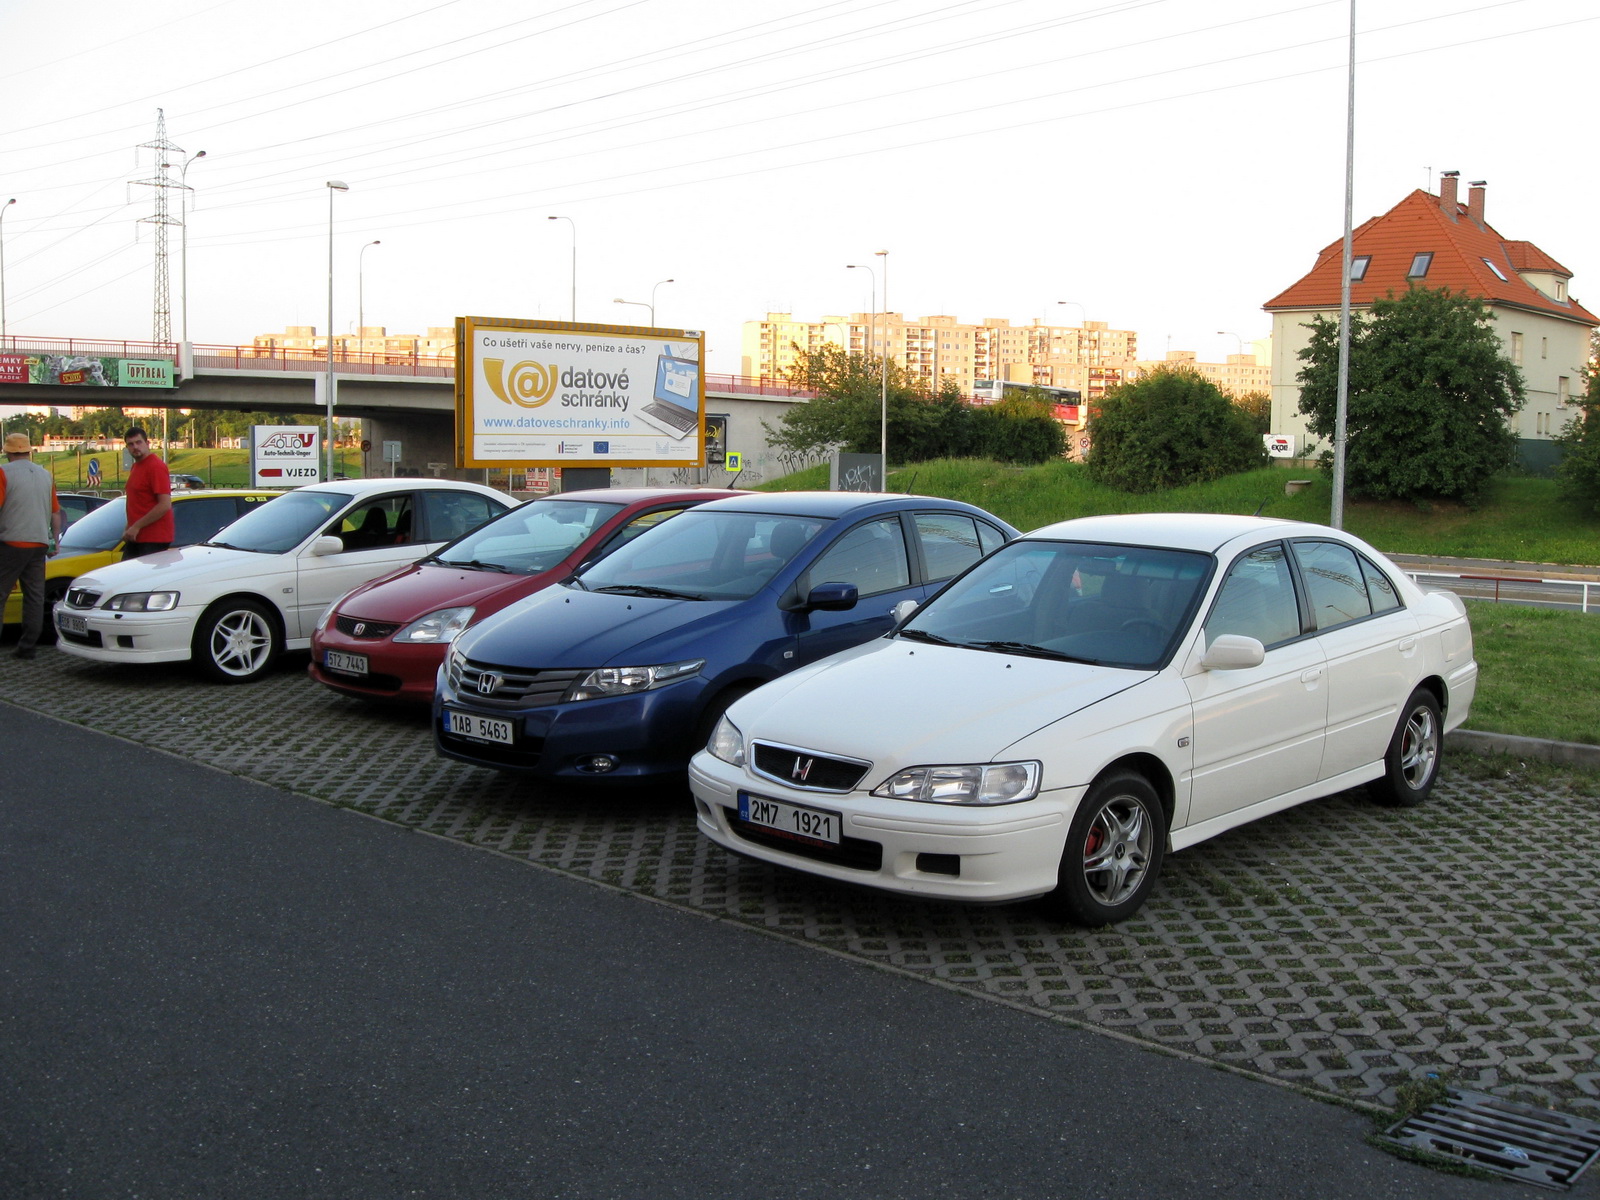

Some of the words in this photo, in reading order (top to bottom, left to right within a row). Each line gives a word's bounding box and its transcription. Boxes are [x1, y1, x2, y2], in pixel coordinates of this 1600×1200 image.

[483, 337, 497, 348] Co
[530, 339, 553, 350] vaše
[555, 341, 583, 353] nervy,
[618, 345, 623, 353] a
[130, 366, 166, 378] OPTREAL
[560, 366, 630, 390] datové
[560, 390, 630, 413] schránky
[483, 417, 630, 431] www.datoveschranky.info
[286, 468, 317, 477] VJEZD
[328, 652, 342, 667] 5T2
[346, 656, 365, 672] 7443
[452, 714, 472, 733] 1AB
[479, 720, 508, 741] 5463
[751, 800, 779, 825] 2M7
[792, 810, 831, 839] 1921
